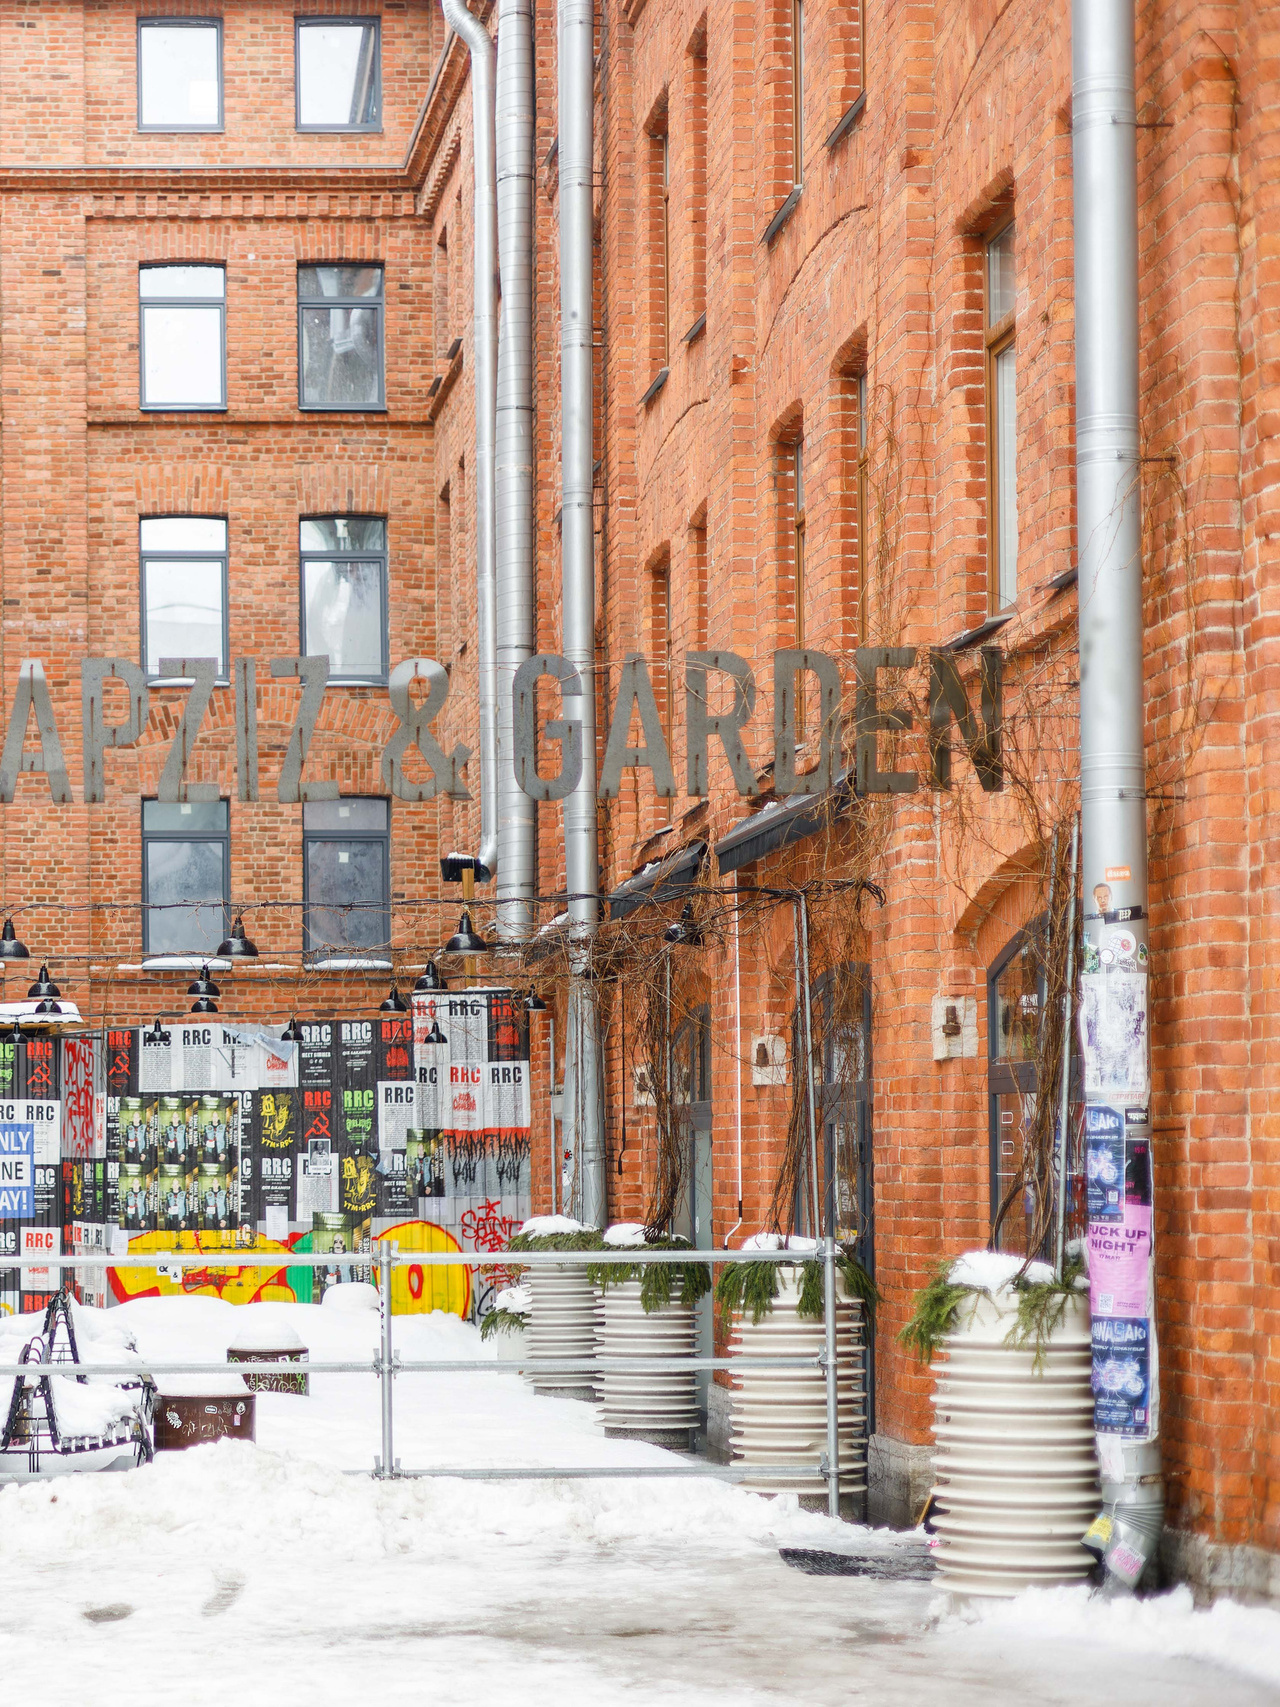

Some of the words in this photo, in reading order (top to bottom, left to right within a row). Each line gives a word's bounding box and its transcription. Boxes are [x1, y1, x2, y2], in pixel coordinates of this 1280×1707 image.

[381, 657, 473, 801] &
[513, 645, 1004, 799] GARDEN
[449, 1000, 481, 1016] RRC
[491, 998, 520, 1016] RR
[183, 1029, 212, 1045] RRC
[301, 1025, 332, 1042] RRC
[341, 1022, 372, 1040] RRC
[381, 1020, 413, 1038] RRC
[108, 1031, 132, 1046] RRC
[27, 1042, 53, 1056] RRC
[415, 1067, 437, 1083] RC
[450, 1066, 481, 1083] RRC
[491, 1066, 523, 1083] RRC
[304, 1091, 332, 1106] RRC
[344, 1090, 374, 1107] RRC
[384, 1086, 414, 1103] RRC
[26, 1105, 55, 1120] RRC
[262, 1157, 292, 1174] RRC
[35, 1168, 56, 1184] RC
[25, 1233, 53, 1247] RRC
[1089, 1223, 1120, 1238] FUCK
[1125, 1228, 1148, 1240] UP
[1091, 1237, 1137, 1252] NIGHT
